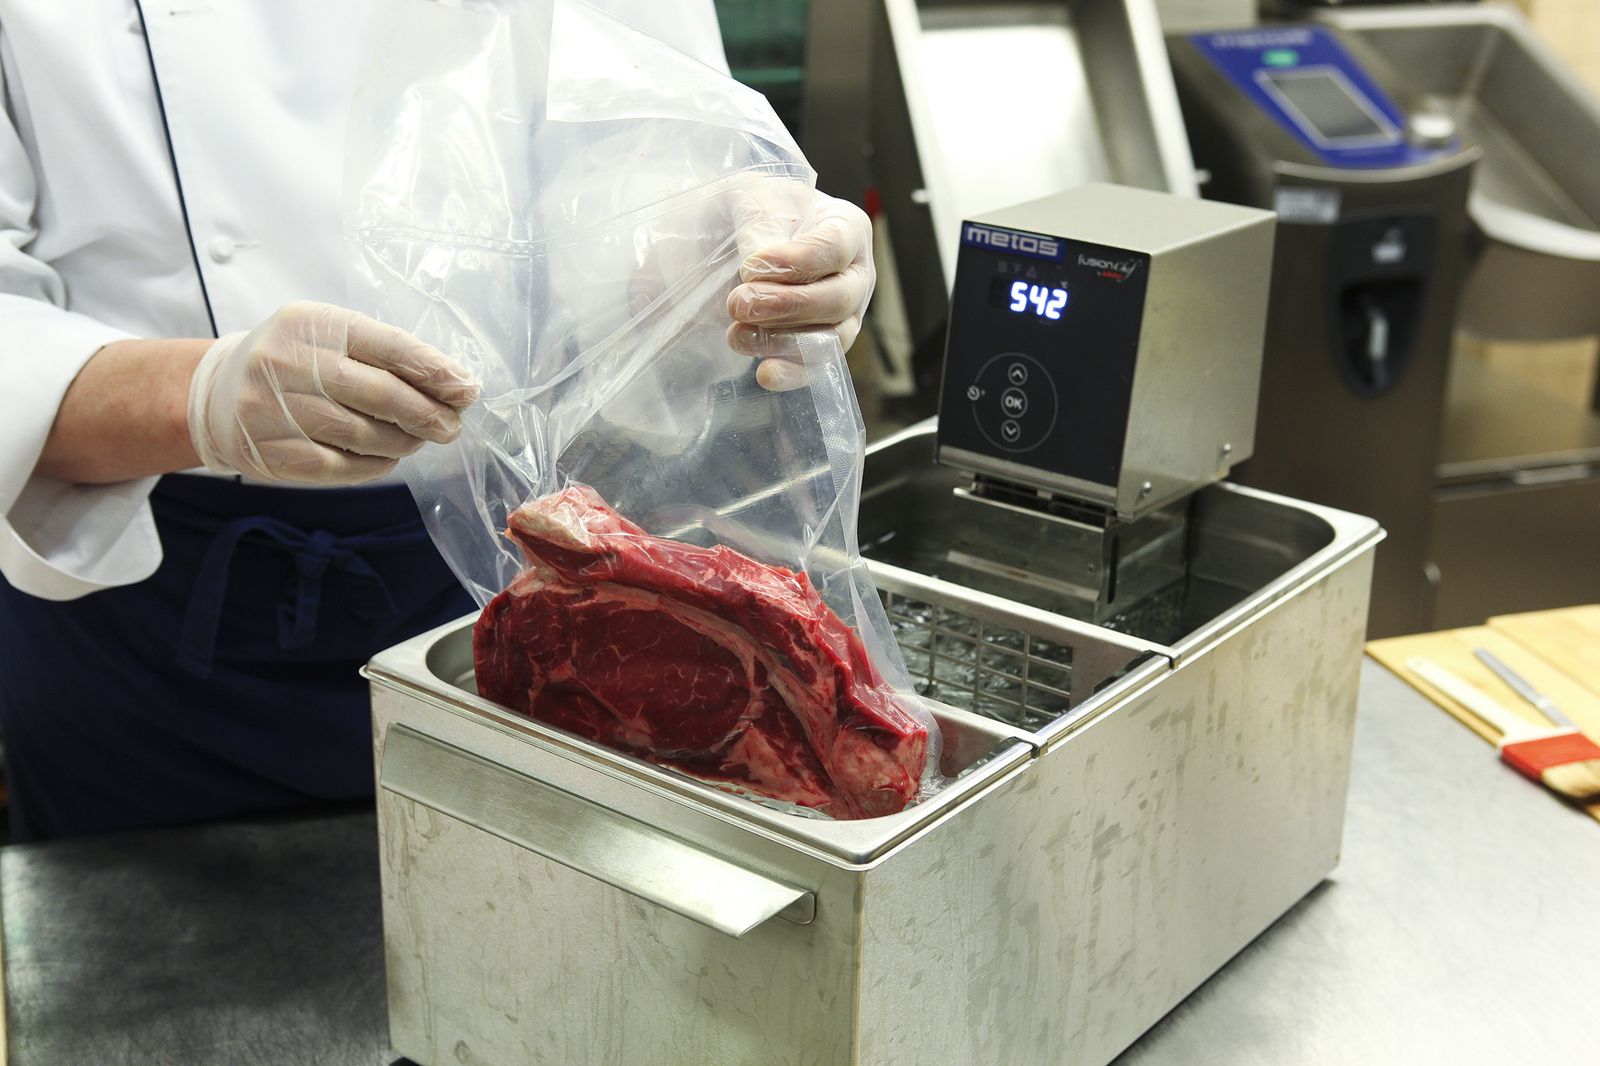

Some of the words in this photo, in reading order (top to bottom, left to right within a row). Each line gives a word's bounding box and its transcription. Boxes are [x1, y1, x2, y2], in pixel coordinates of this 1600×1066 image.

[967, 226, 1058, 257] metos
[1010, 281, 1068, 319] 542
[1005, 395, 1023, 410] OK
